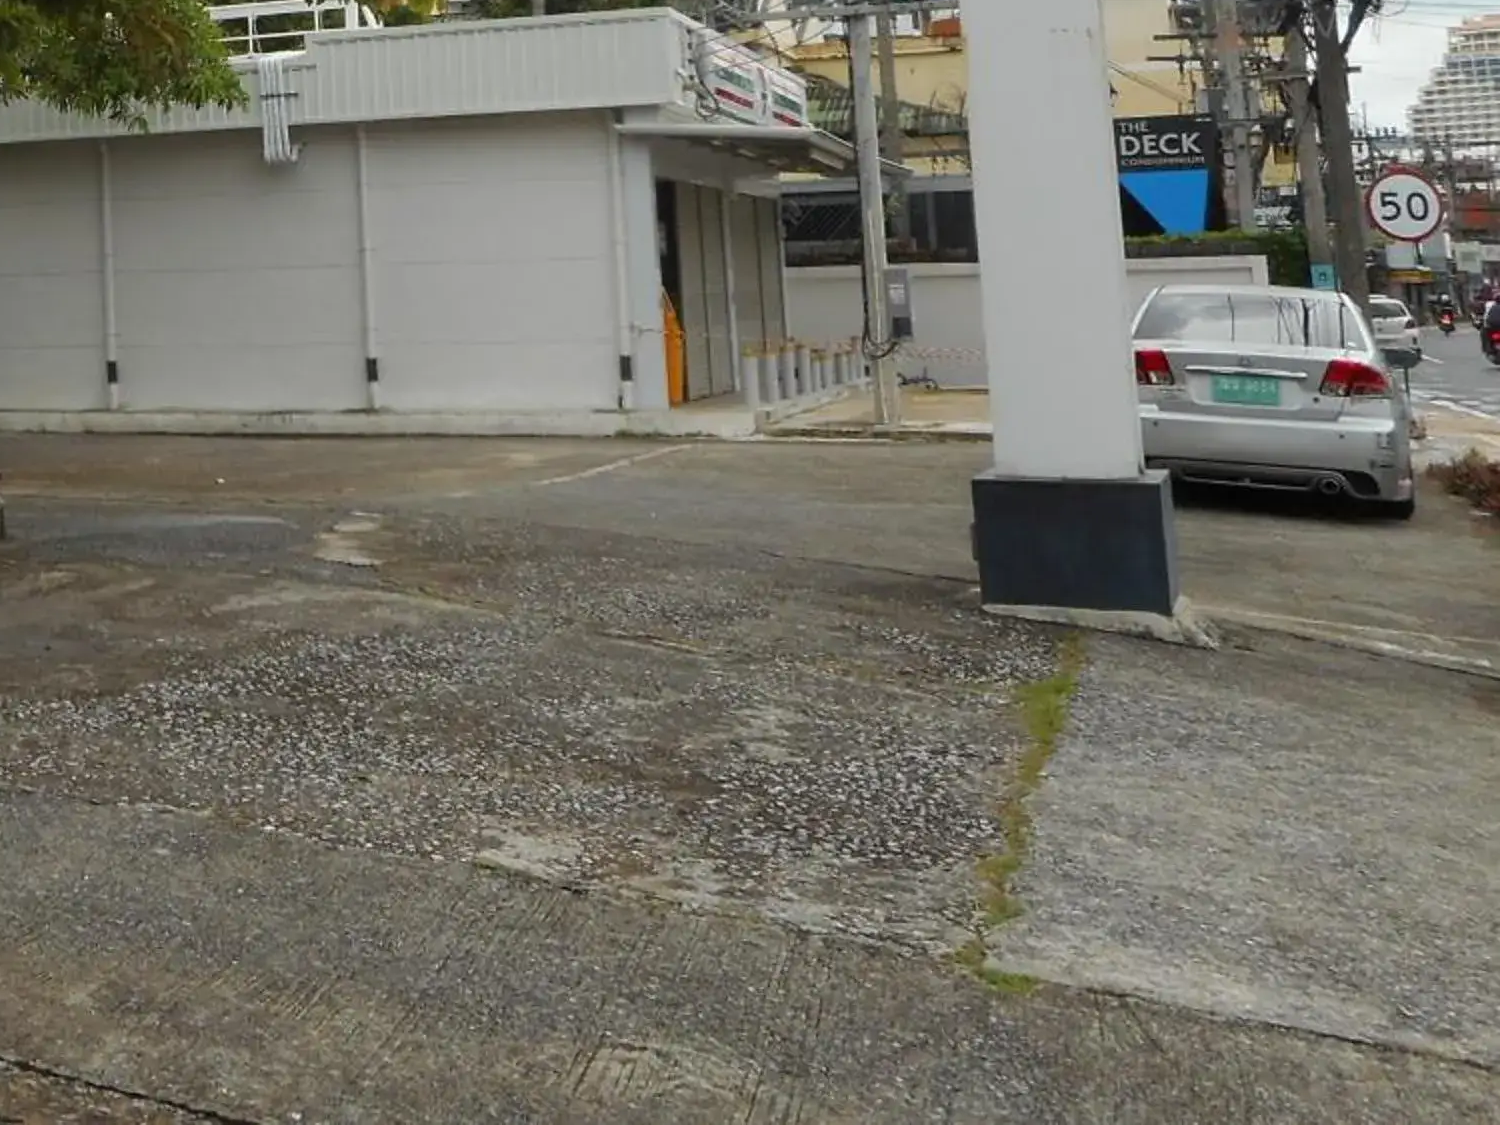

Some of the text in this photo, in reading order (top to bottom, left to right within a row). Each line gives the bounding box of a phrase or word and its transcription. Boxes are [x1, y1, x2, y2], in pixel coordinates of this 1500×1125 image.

[1116, 122, 1149, 134] THE
[1120, 132, 1202, 156] DECK
[1380, 192, 1429, 221] 50
